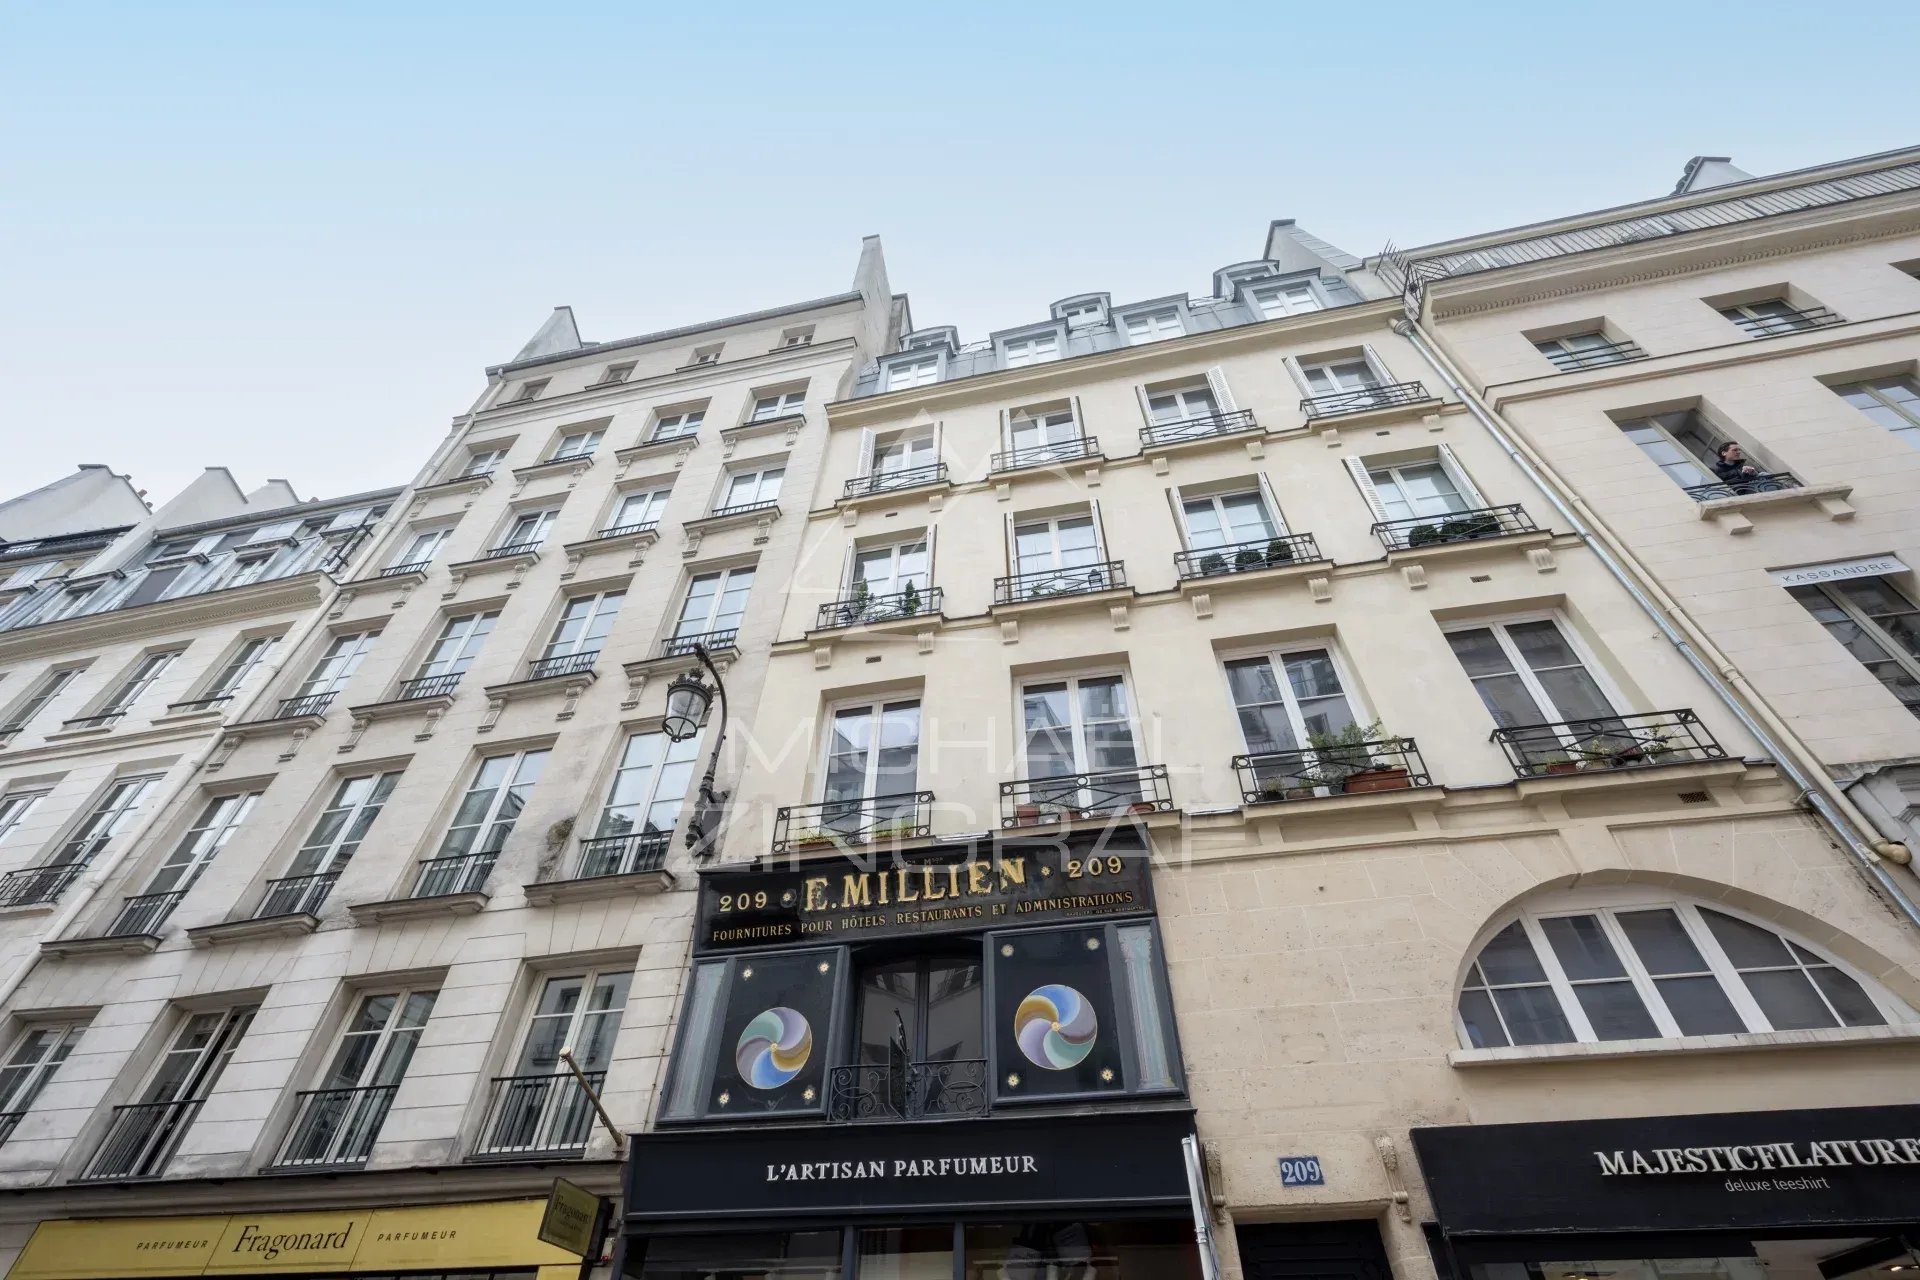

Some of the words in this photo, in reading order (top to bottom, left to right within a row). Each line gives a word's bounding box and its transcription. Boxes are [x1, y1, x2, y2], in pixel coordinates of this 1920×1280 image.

[1782, 562, 1894, 583] KASSANDRE
[719, 891, 768, 913] 209
[1066, 855, 1123, 879] 209
[713, 924, 792, 942] FOURNITURES
[801, 919, 833, 933] POUR
[896, 905, 982, 925] RESTAURANTS
[992, 904, 1008, 916] ET
[1016, 891, 1134, 914] ADMINISTRATIONS
[766, 1160, 886, 1182] L'ARTISAN
[893, 1155, 1039, 1177] PARFUMEUR
[1281, 1160, 1321, 1183] 209
[1593, 1138, 1920, 1176] MAJESTICFILATURE
[1724, 1178, 1771, 1193] deluxe
[1772, 1176, 1832, 1192] teeshirt
[136, 1239, 208, 1251] PARFUMEUR
[232, 1221, 355, 1261] Fragonard
[377, 1229, 457, 1242] PARFUMEUR
